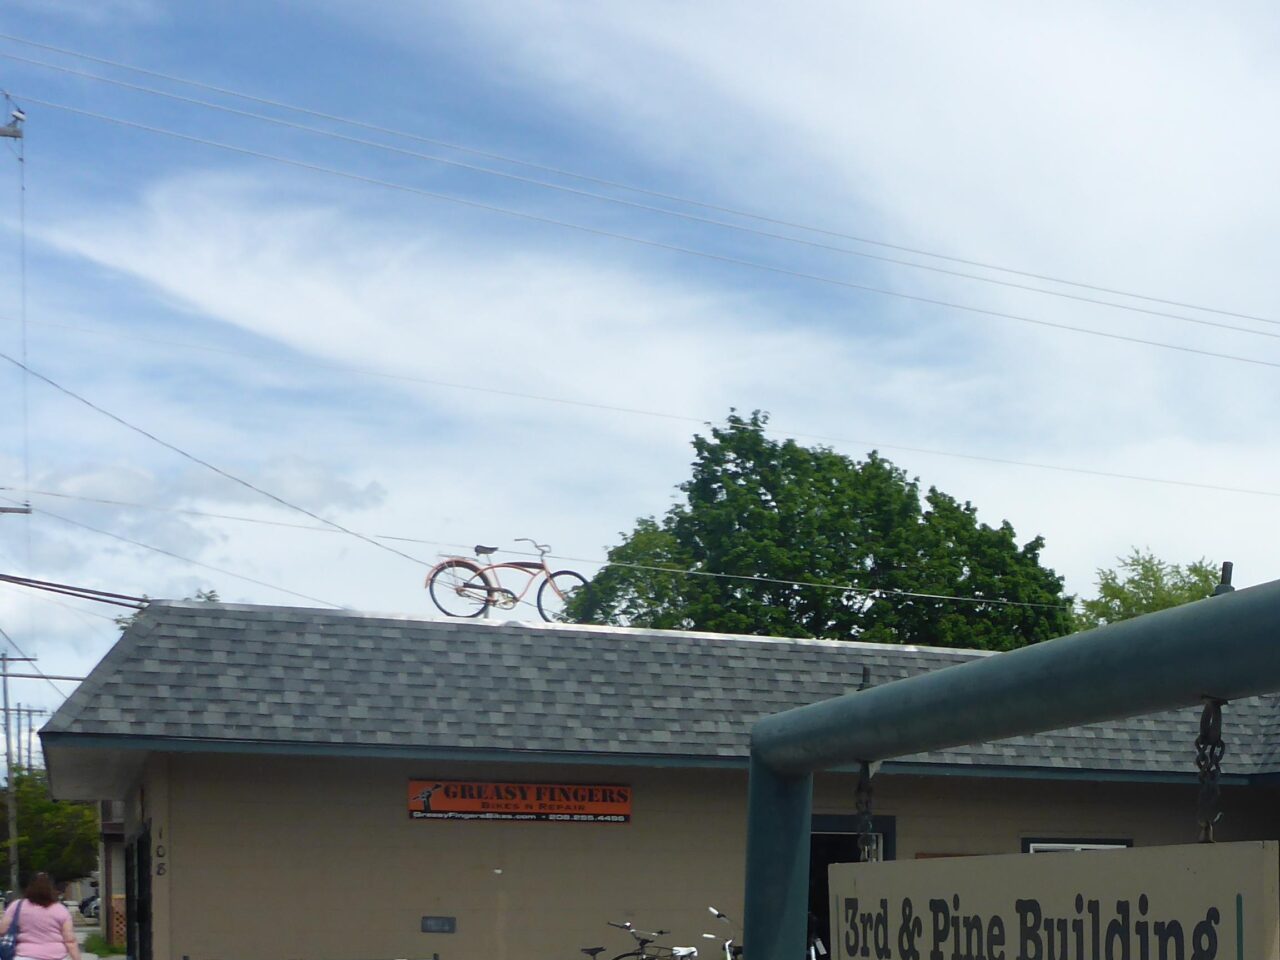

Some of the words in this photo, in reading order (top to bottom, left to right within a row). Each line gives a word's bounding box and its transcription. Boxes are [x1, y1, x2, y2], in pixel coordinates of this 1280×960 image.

[443, 783, 530, 801] GREASY
[536, 785, 629, 804] FINGERS
[844, 897, 892, 960] 3rd
